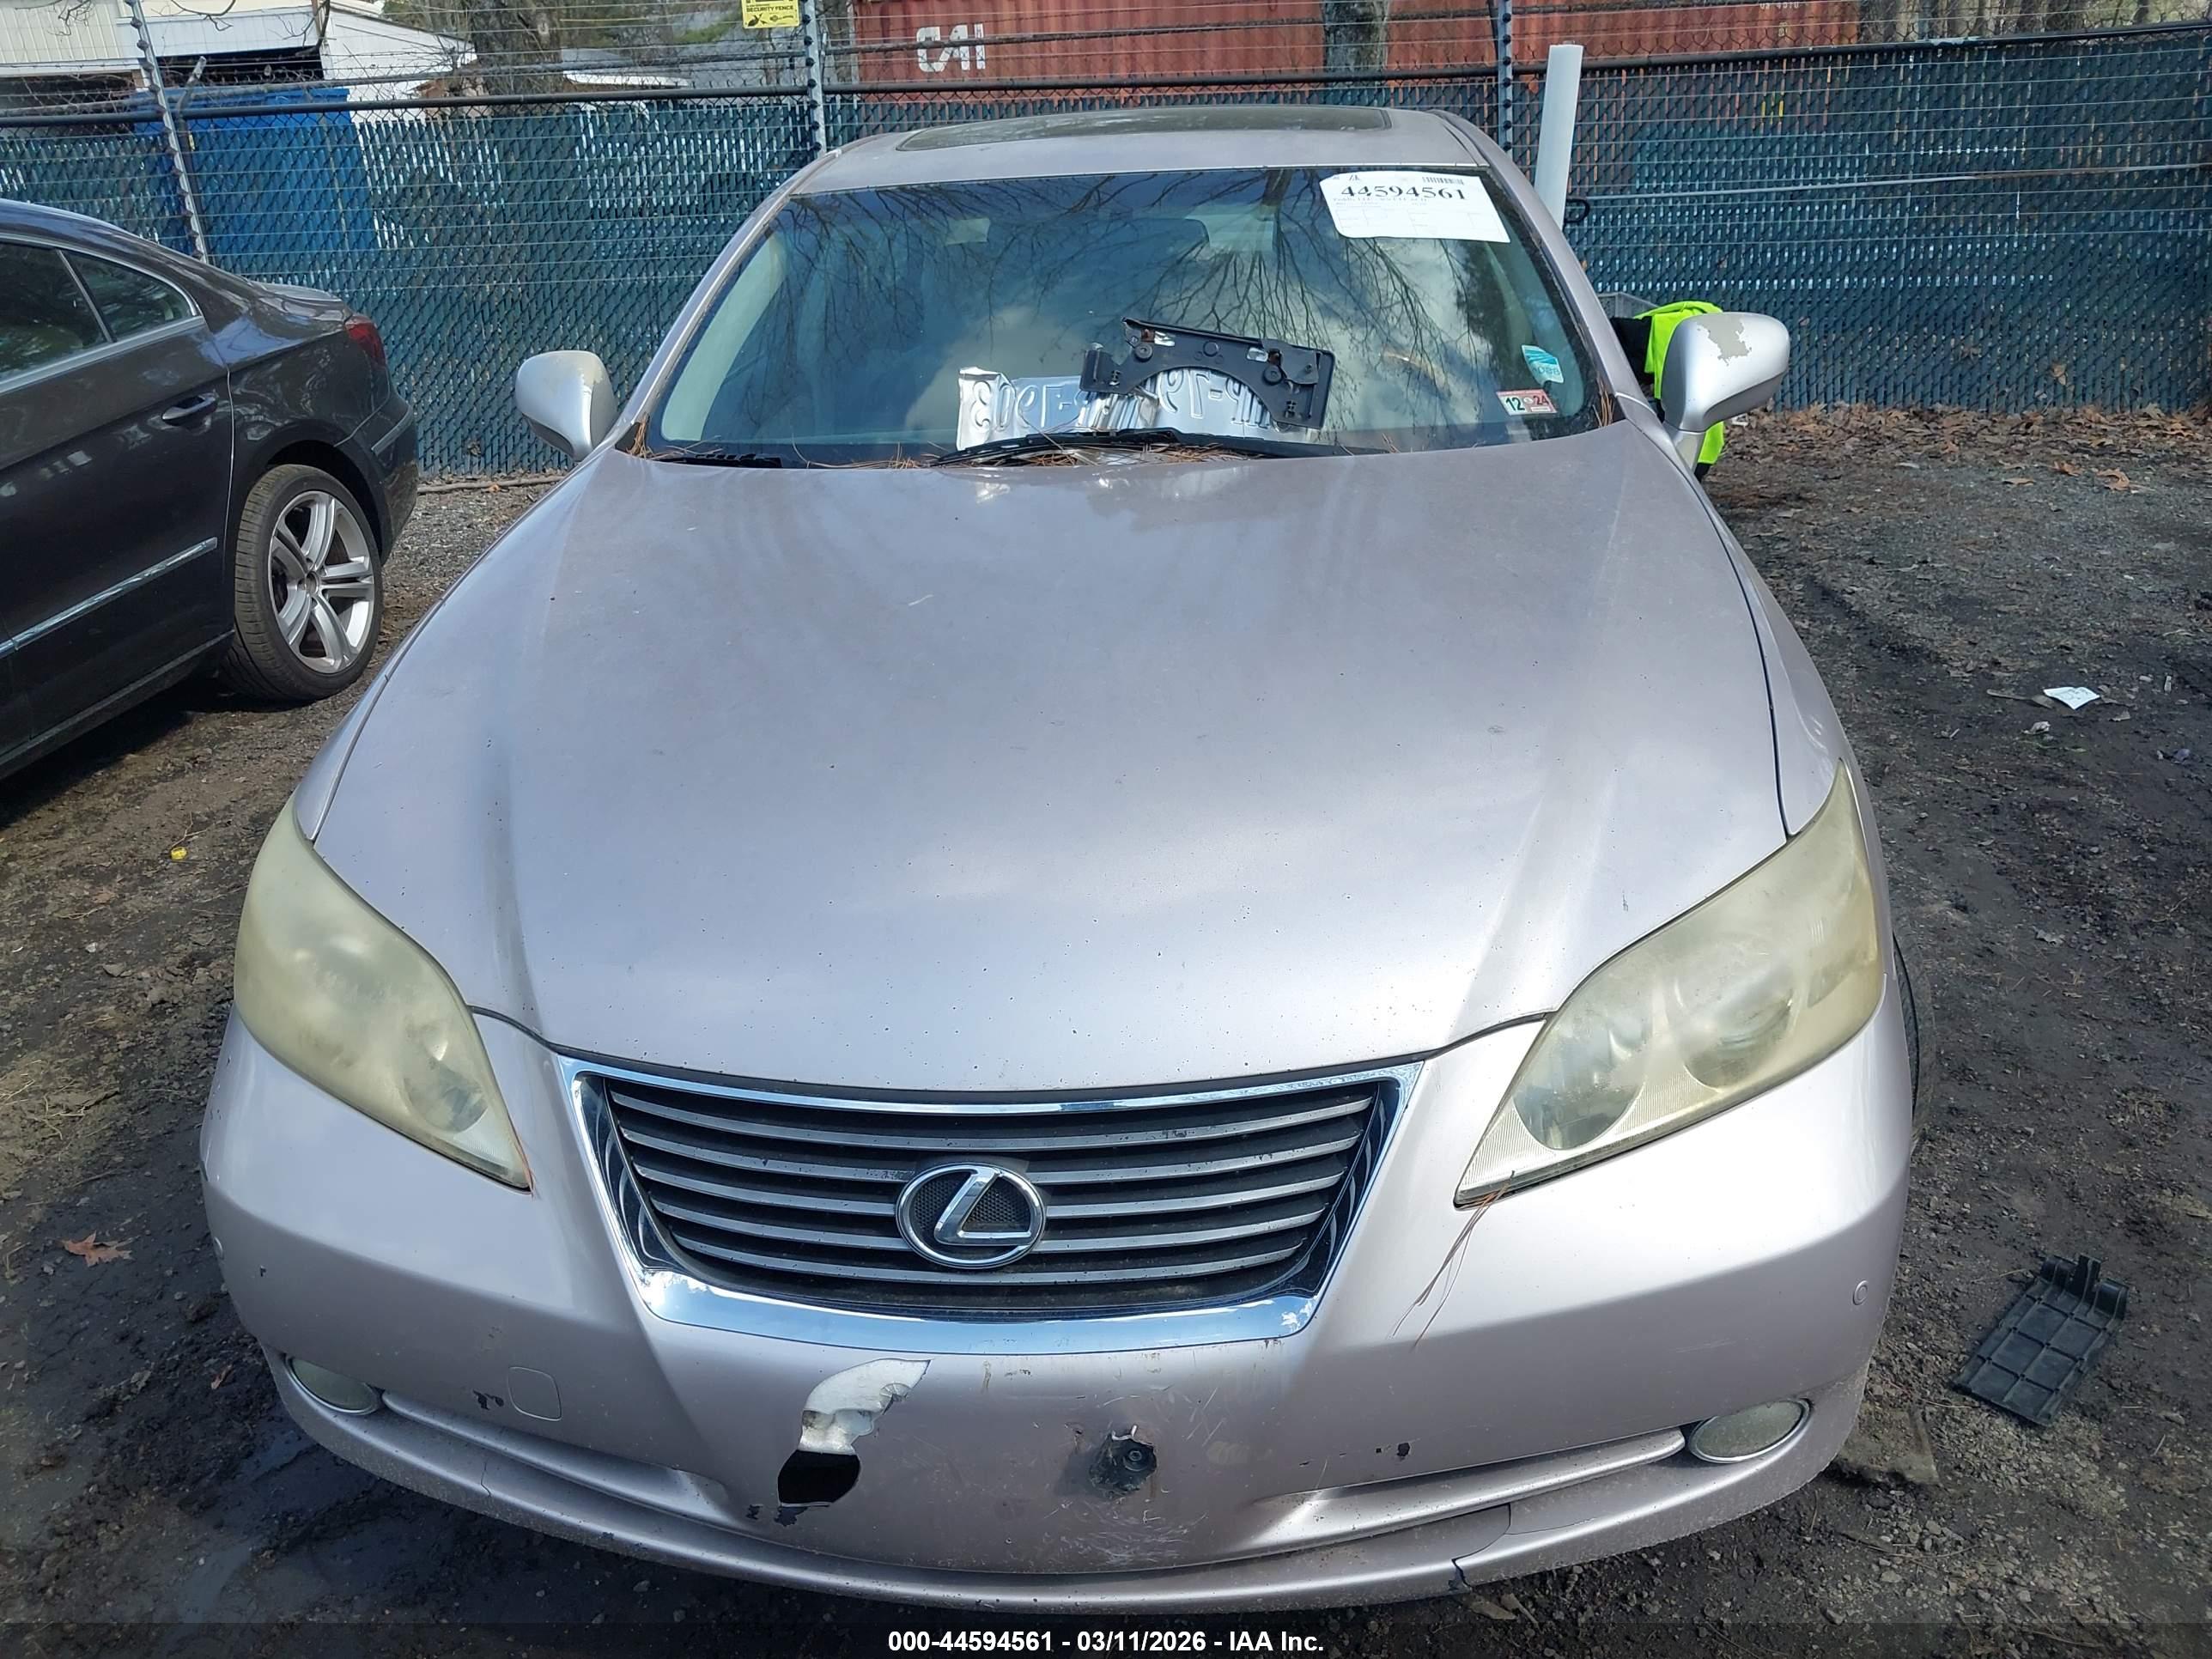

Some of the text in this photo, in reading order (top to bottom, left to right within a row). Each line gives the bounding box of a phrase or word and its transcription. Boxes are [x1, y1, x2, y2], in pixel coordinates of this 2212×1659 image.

[916, 23, 986, 72] CAI
[1341, 185, 1467, 200] 44594561
[1505, 397, 1525, 411] 12
